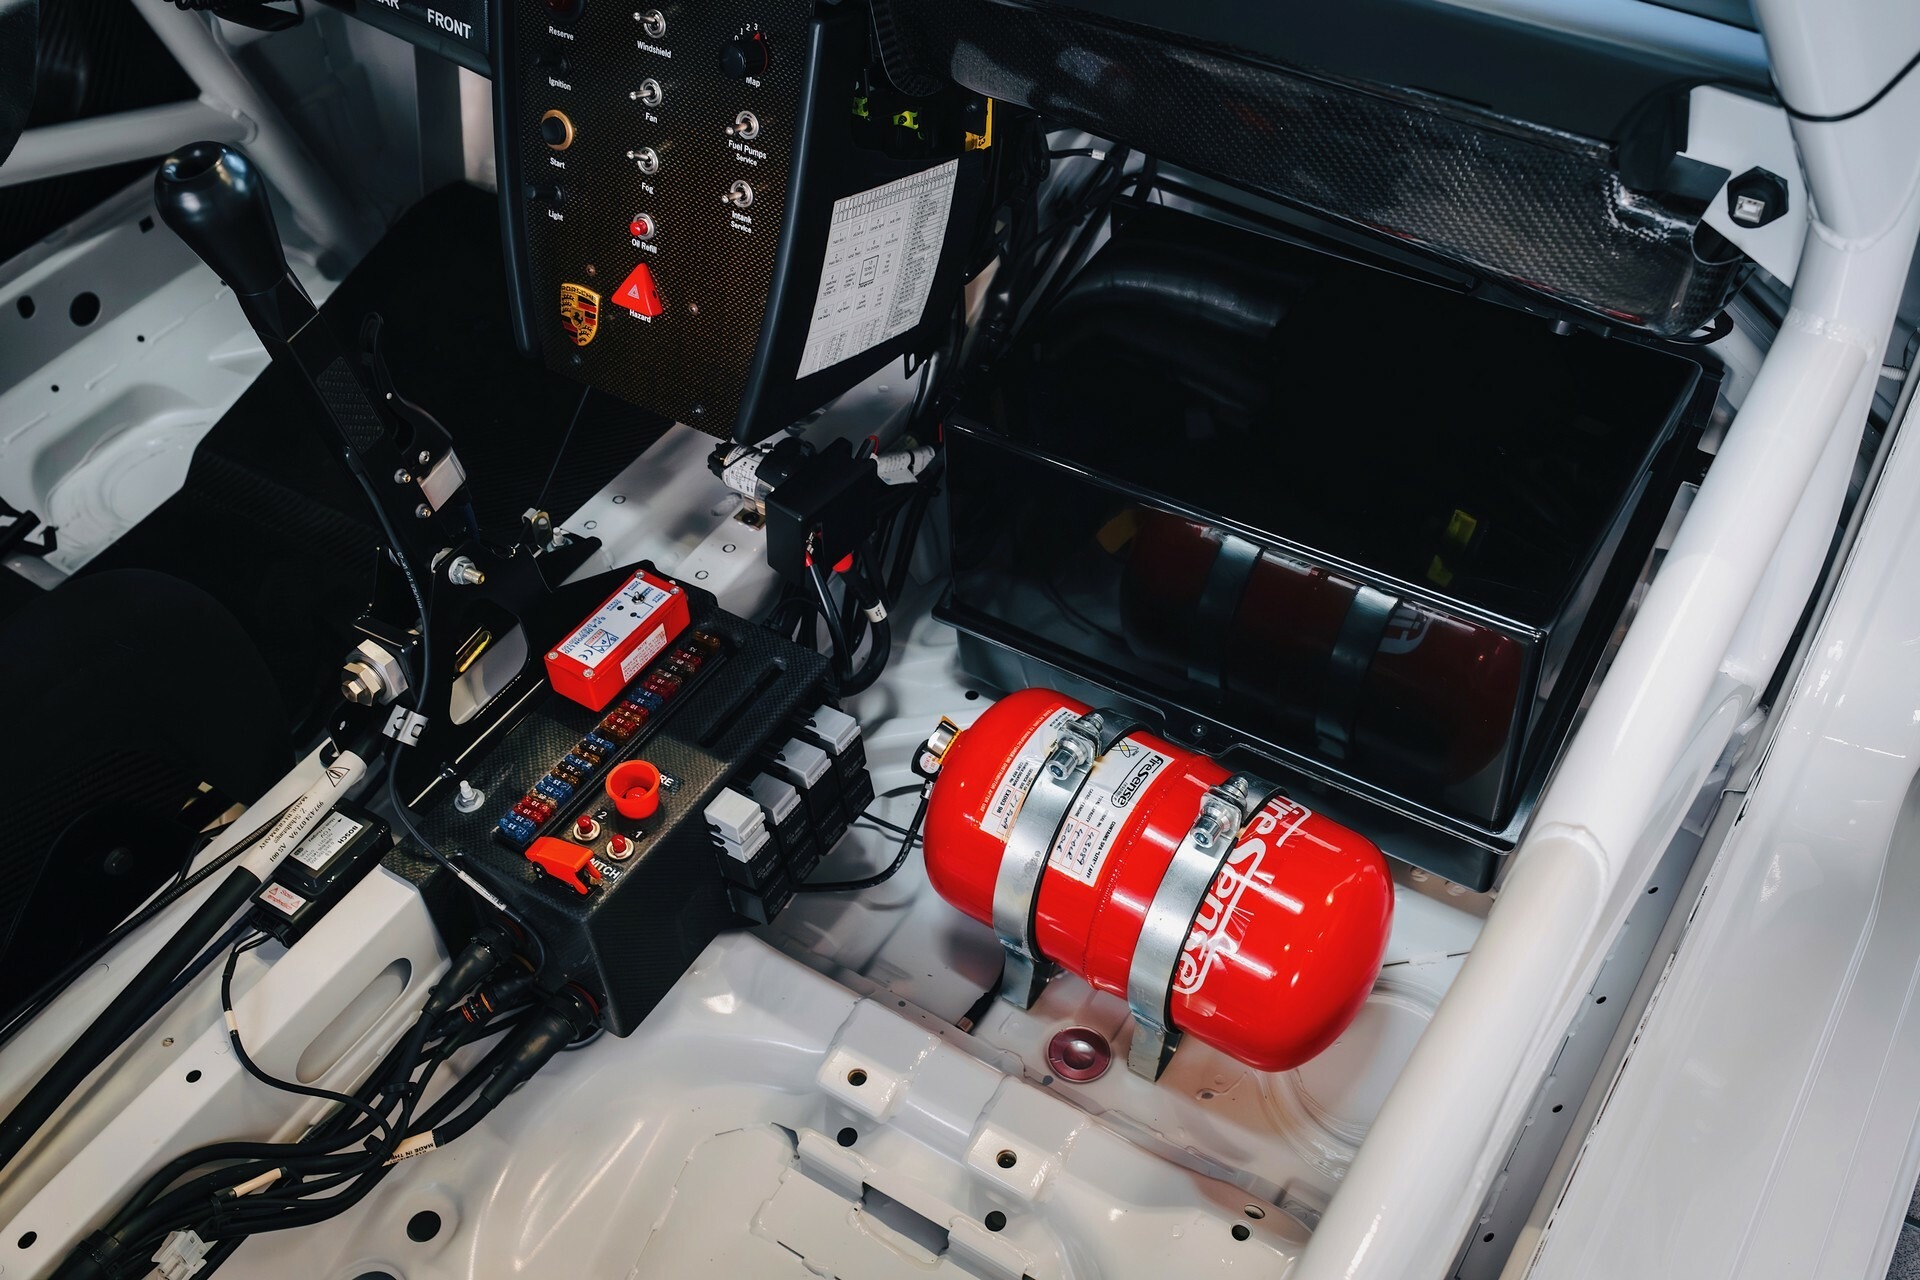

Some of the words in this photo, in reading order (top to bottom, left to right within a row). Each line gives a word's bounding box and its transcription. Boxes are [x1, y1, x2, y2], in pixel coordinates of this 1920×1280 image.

[427, 8, 471, 39] FRONT
[745, 23, 751, 32] 2
[753, 22, 759, 31] 3
[548, 25, 574, 41] Reserve
[636, 40, 672, 59] Windshield
[548, 76, 572, 91] Ignition
[745, 76, 760, 88] Map
[645, 111, 658, 124] Fan
[728, 139, 743, 152] Fuel
[744, 144, 767, 160] Pumps
[549, 157, 565, 169] Start
[735, 152, 758, 167] Service
[641, 181, 654, 194] Fog
[548, 209, 564, 221] Light
[730, 220, 752, 234] Service
[631, 238, 641, 248] Oil
[641, 241, 658, 254] Refill
[629, 309, 652, 323] Hazard
[1009, 730, 1031, 758] MANUFACTURER
[990, 763, 1008, 790] DISTRIBUTOR
[983, 789, 993, 803] AFTER
[597, 811, 608, 820] 2
[338, 825, 358, 844] BOSCH
[635, 831, 643, 839] 1
[1103, 821, 1116, 842] CONTAINS
[1098, 842, 1106, 851] SPA
[414, 1143, 433, 1153] MADE
